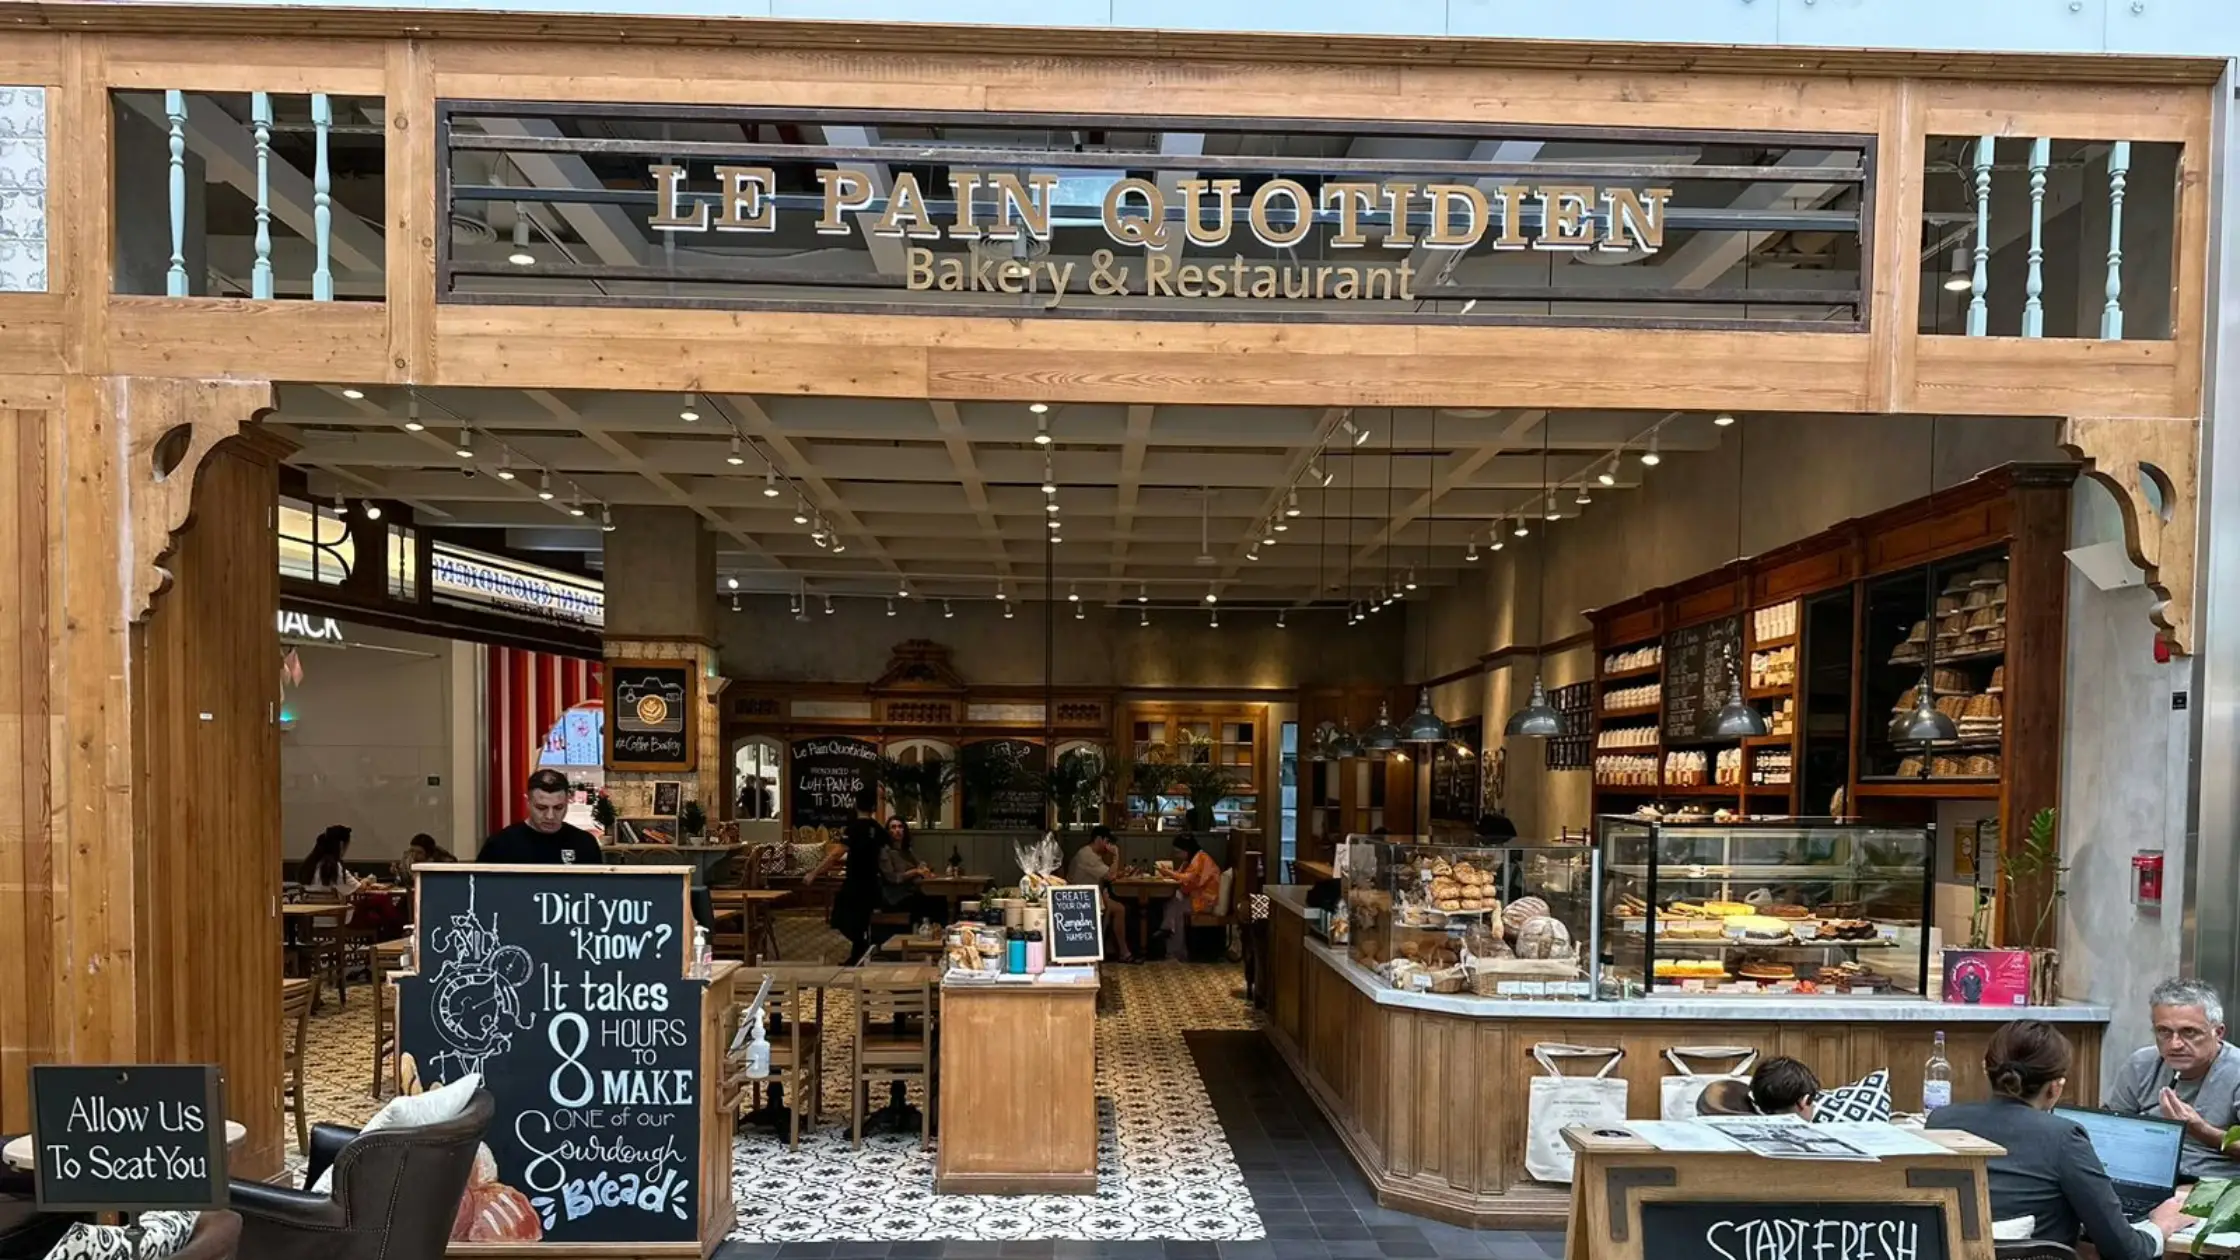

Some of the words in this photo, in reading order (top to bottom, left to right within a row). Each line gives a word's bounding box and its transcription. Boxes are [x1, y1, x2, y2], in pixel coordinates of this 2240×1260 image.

[648, 165, 777, 232] LE
[815, 169, 1060, 240] PAIN
[1102, 178, 1673, 253] QUOTIDIEN
[906, 246, 1075, 308] Bakery
[1089, 249, 1129, 297] &
[1149, 251, 1415, 301] Restaurant
[534, 893, 593, 925] Did
[596, 898, 653, 931] you
[1055, 891, 1091, 901] CREATE
[1057, 902, 1075, 910] YOUR
[1076, 902, 1092, 910] OWN
[569, 923, 672, 965] know?
[540, 963, 569, 1012] It
[580, 971, 669, 1012] takes
[548, 1011, 594, 1107] 8
[601, 1018, 687, 1048] HOURS
[631, 1048, 657, 1066] TO
[602, 1070, 693, 1106] MAKE
[66, 1096, 149, 1133] Allow
[158, 1101, 204, 1132] Us
[552, 1109, 604, 1130] ONE
[611, 1107, 629, 1126] of
[636, 1112, 675, 1127] our
[47, 1144, 82, 1180] To
[88, 1145, 157, 1181] Seat
[155, 1145, 207, 1181] You
[514, 1110, 686, 1192] Sourdough
